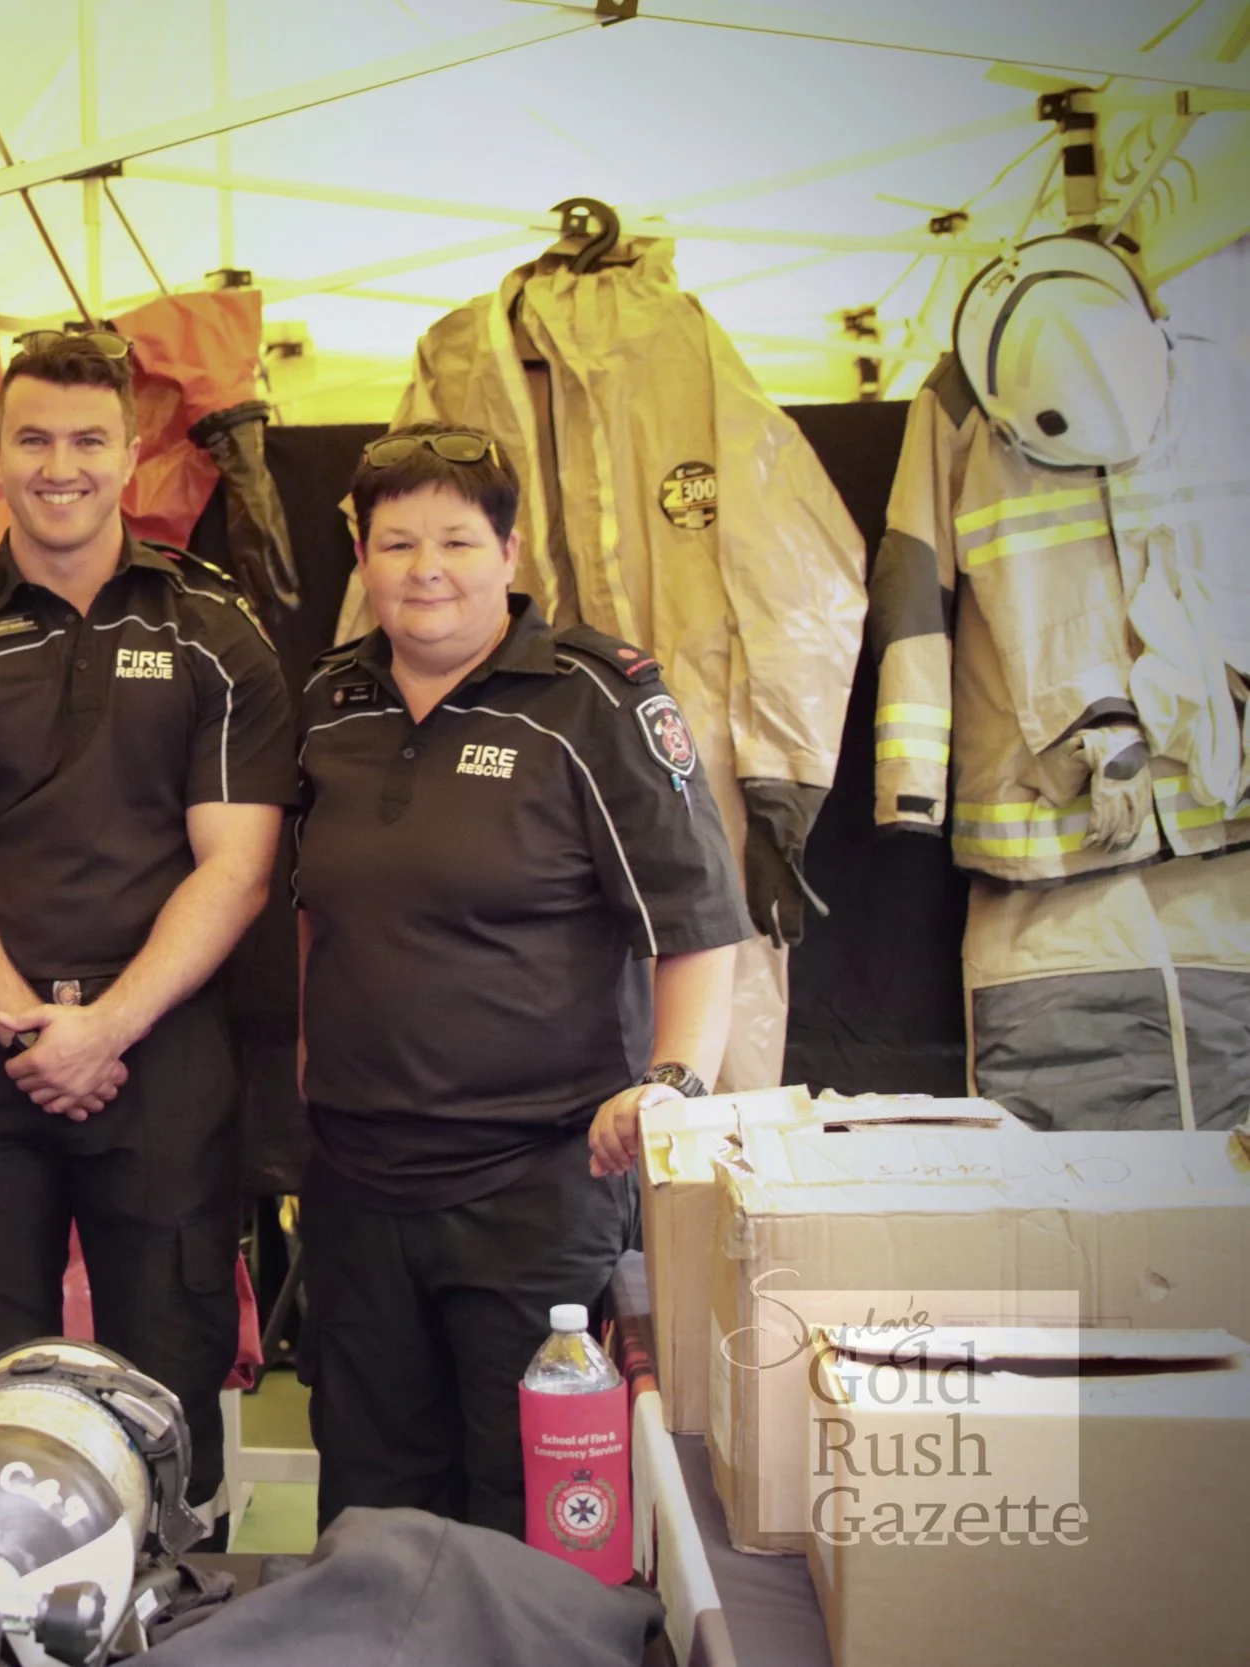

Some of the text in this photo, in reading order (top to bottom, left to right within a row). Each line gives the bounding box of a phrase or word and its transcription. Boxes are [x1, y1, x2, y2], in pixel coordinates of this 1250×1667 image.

[117, 648, 173, 668] FIRE
[115, 666, 173, 680] RESCUE
[460, 744, 519, 768] FIRE
[456, 762, 514, 779] RESCUE
[541, 1433, 576, 1445] School
[577, 1434, 589, 1445] of
